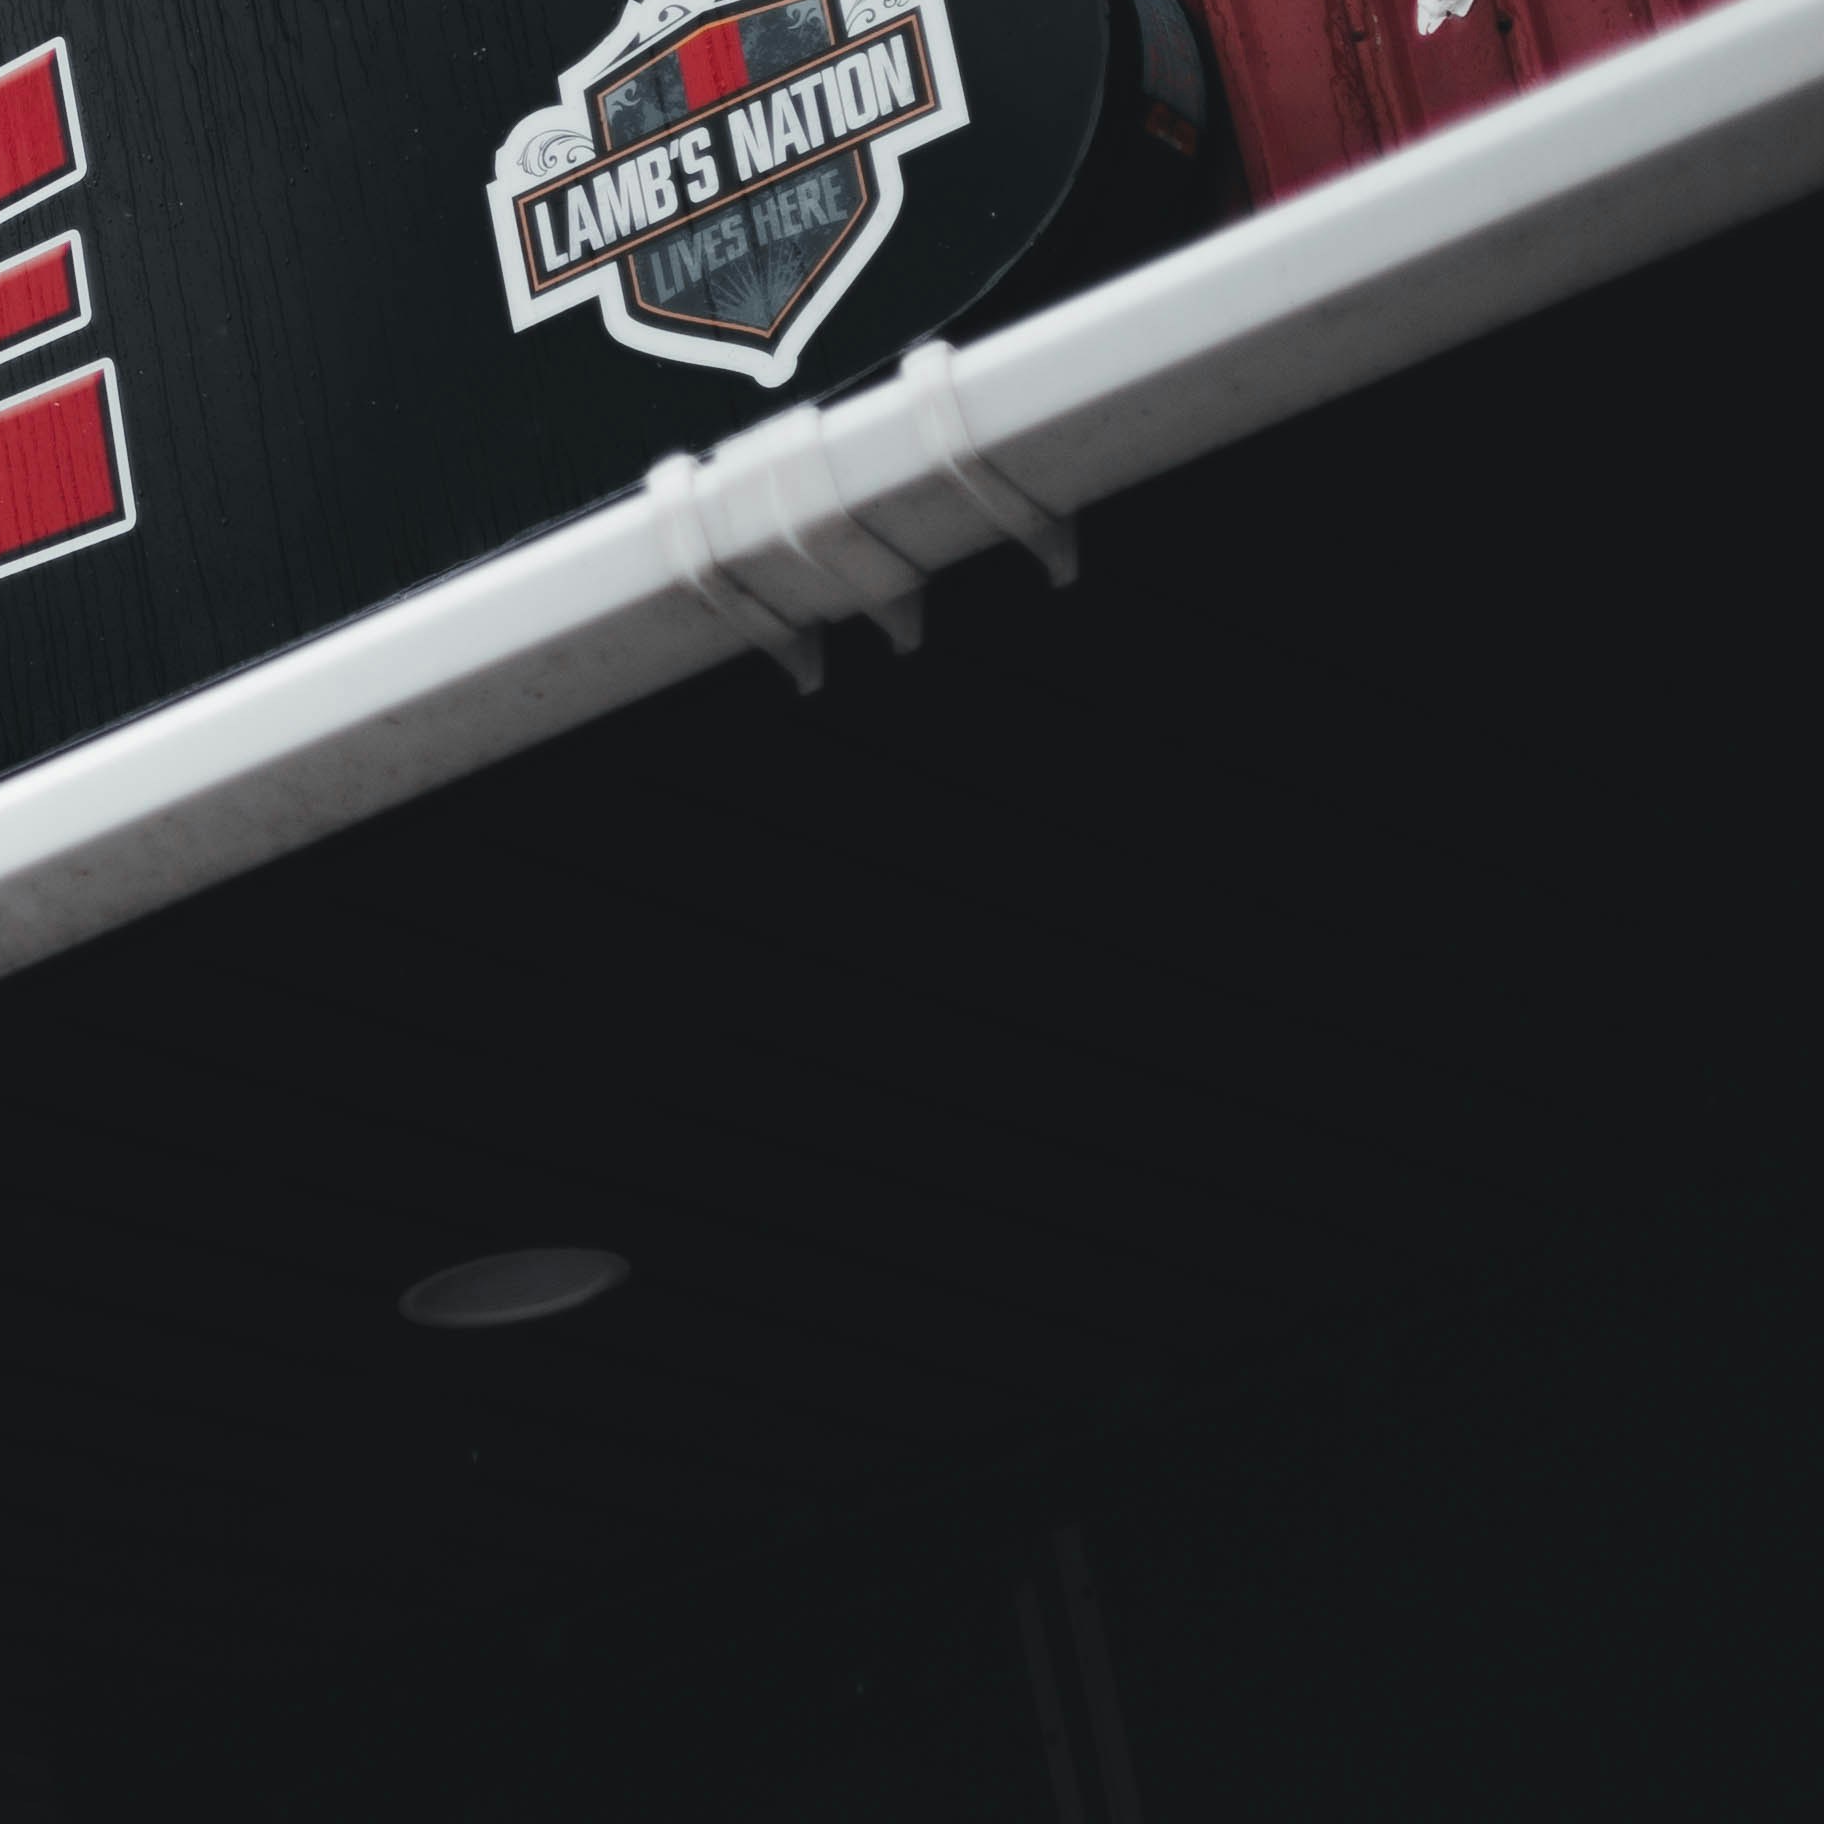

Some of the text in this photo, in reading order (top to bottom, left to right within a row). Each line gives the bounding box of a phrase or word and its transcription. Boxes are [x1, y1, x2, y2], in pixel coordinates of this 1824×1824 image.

[534, 34, 916, 273] LAMB'S NATION
[651, 167, 848, 304] LIVES HERE
